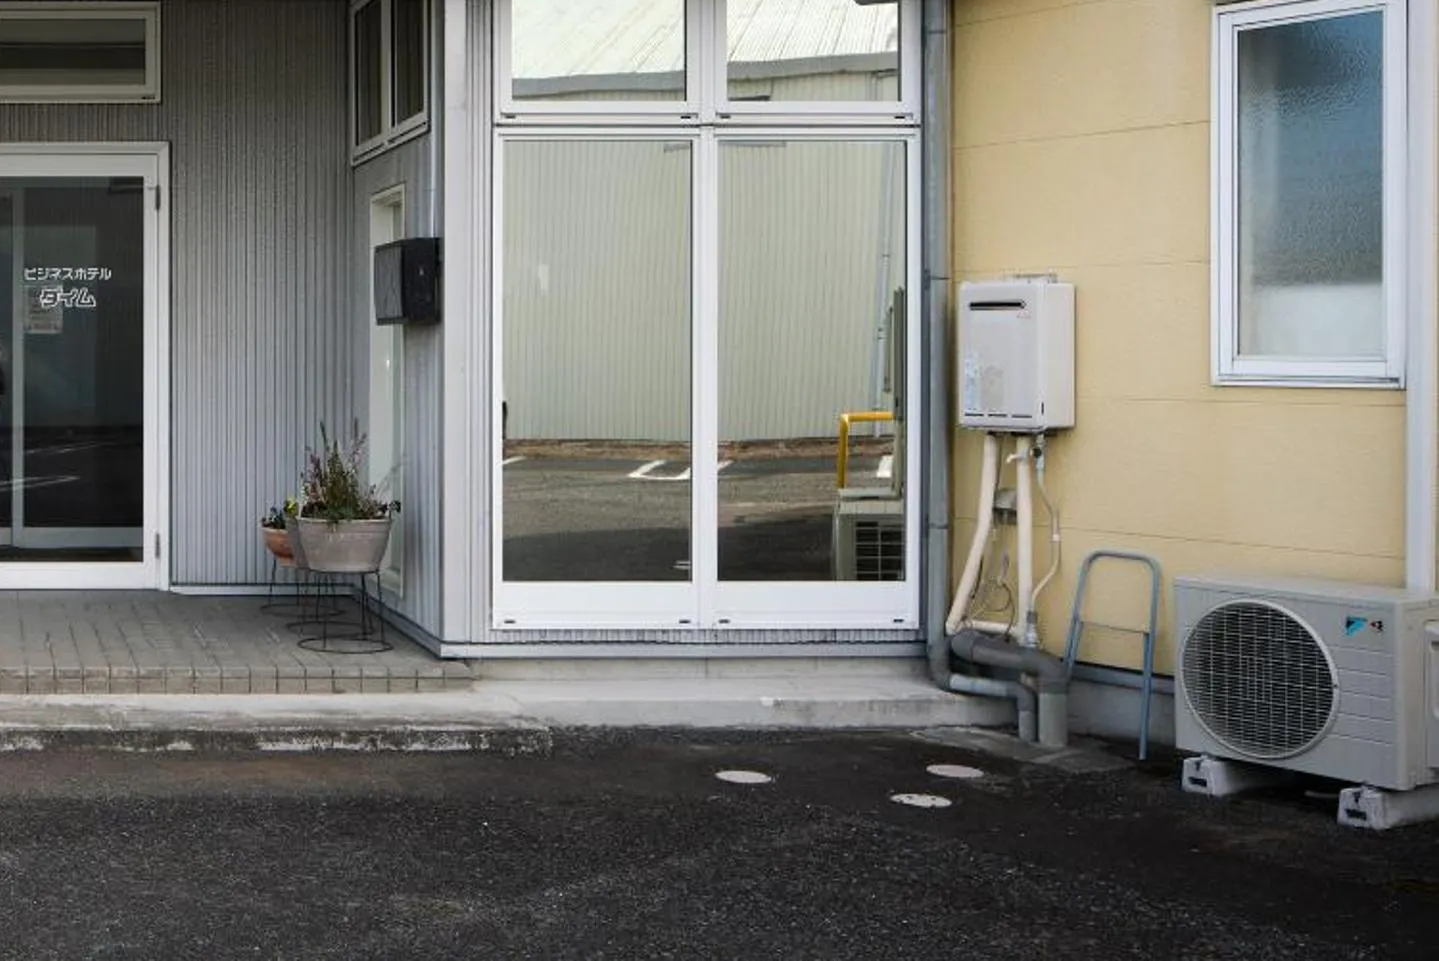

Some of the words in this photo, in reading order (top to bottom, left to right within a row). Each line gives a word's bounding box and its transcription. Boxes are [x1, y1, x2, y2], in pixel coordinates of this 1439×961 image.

[23, 267, 112, 280] ビジネスホテル
